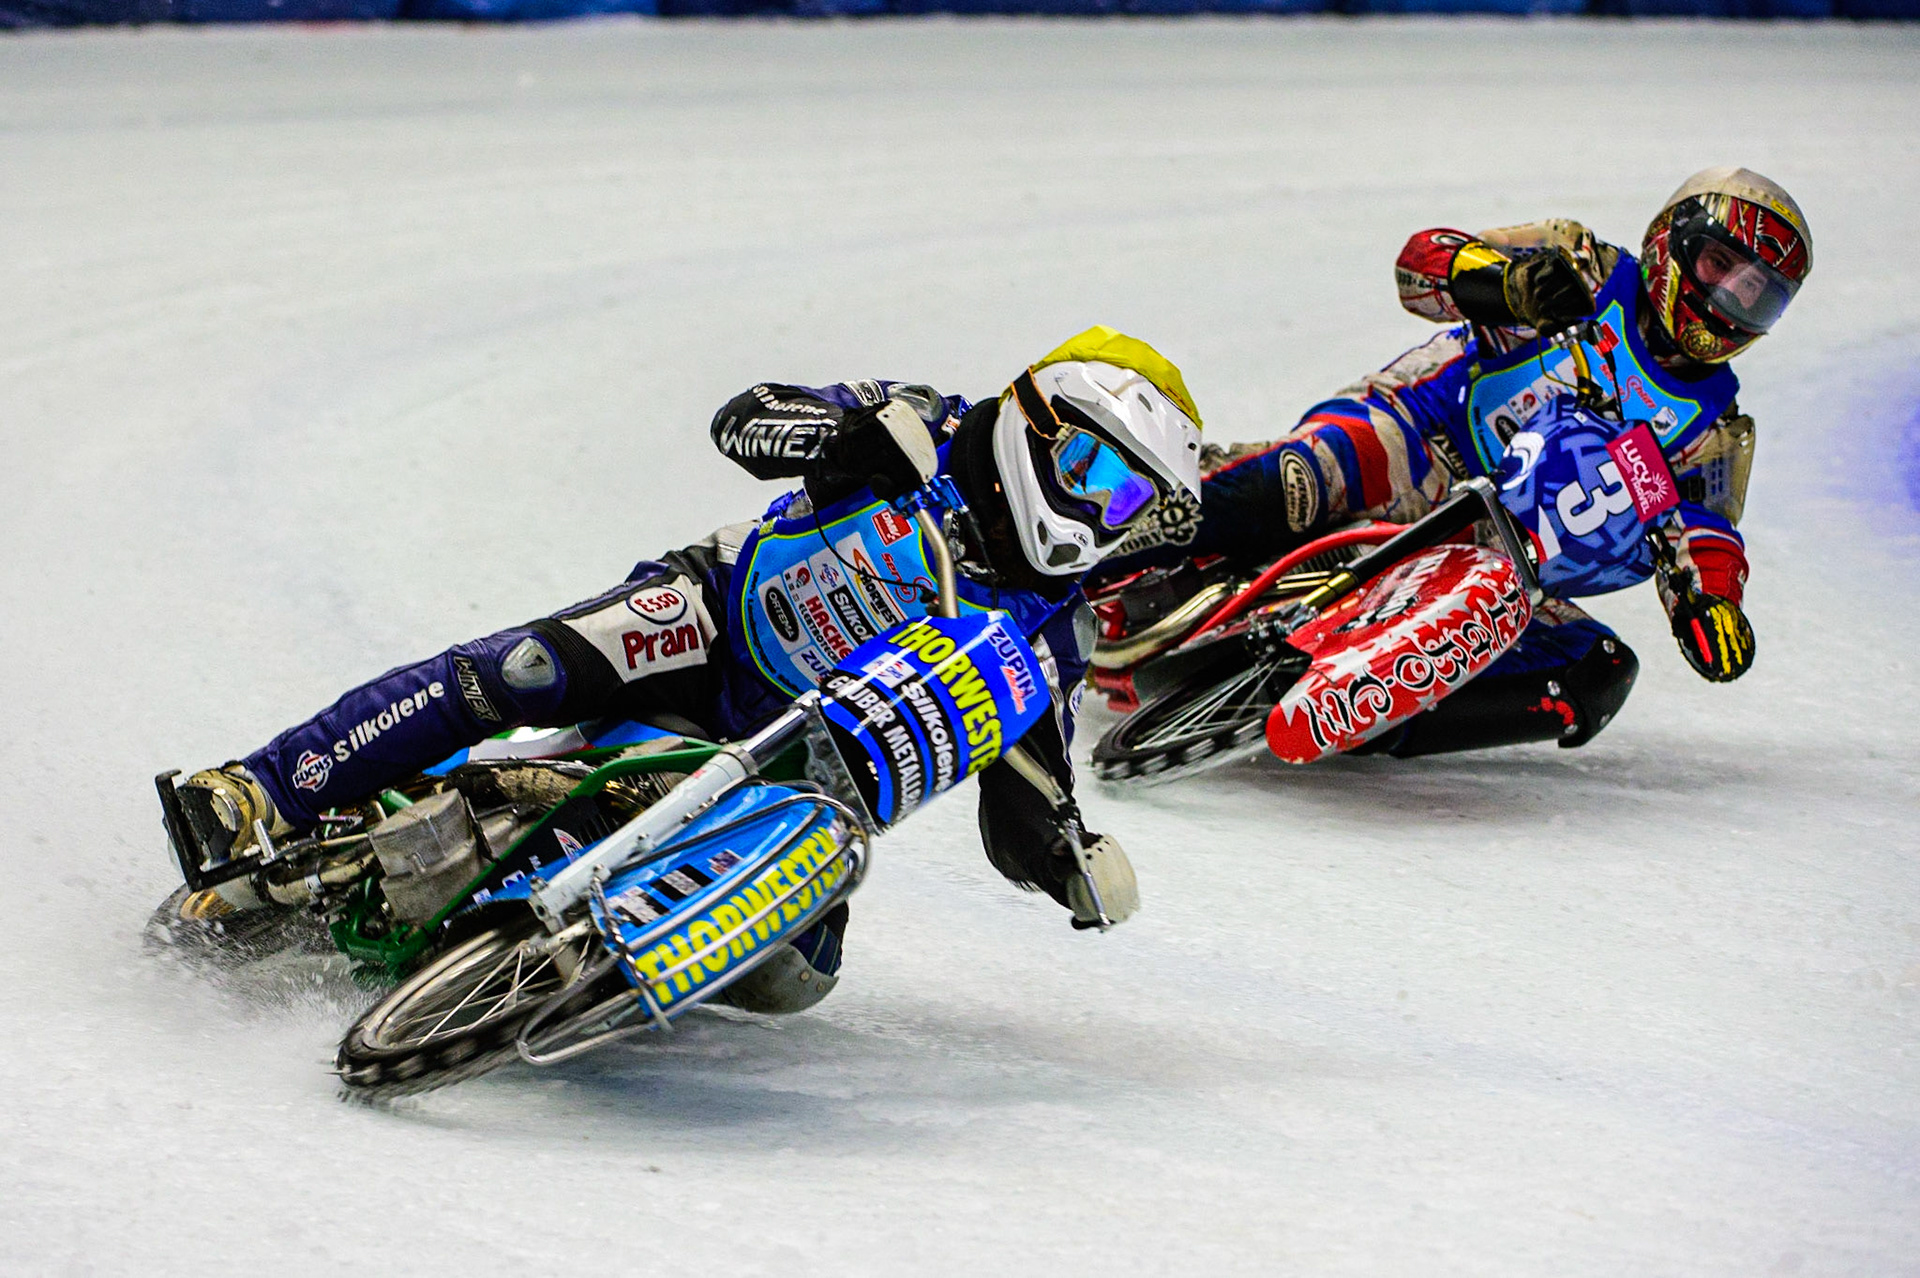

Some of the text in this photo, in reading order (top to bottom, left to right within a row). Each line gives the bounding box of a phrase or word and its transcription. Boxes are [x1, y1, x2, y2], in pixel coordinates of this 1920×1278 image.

[1620, 438, 1653, 485] LUCY
[1556, 459, 1635, 538] 3
[1631, 475, 1652, 516] TRAVEL
[768, 590, 796, 639] ORTEMA
[805, 595, 853, 660] HACHE
[834, 590, 874, 641] Silkol
[622, 623, 700, 671] Pran
[988, 625, 1038, 700] ZUPIN
[333, 681, 446, 763] Silkolene
[888, 621, 1002, 780] THORWESTE
[294, 754, 333, 787] FUCHS
